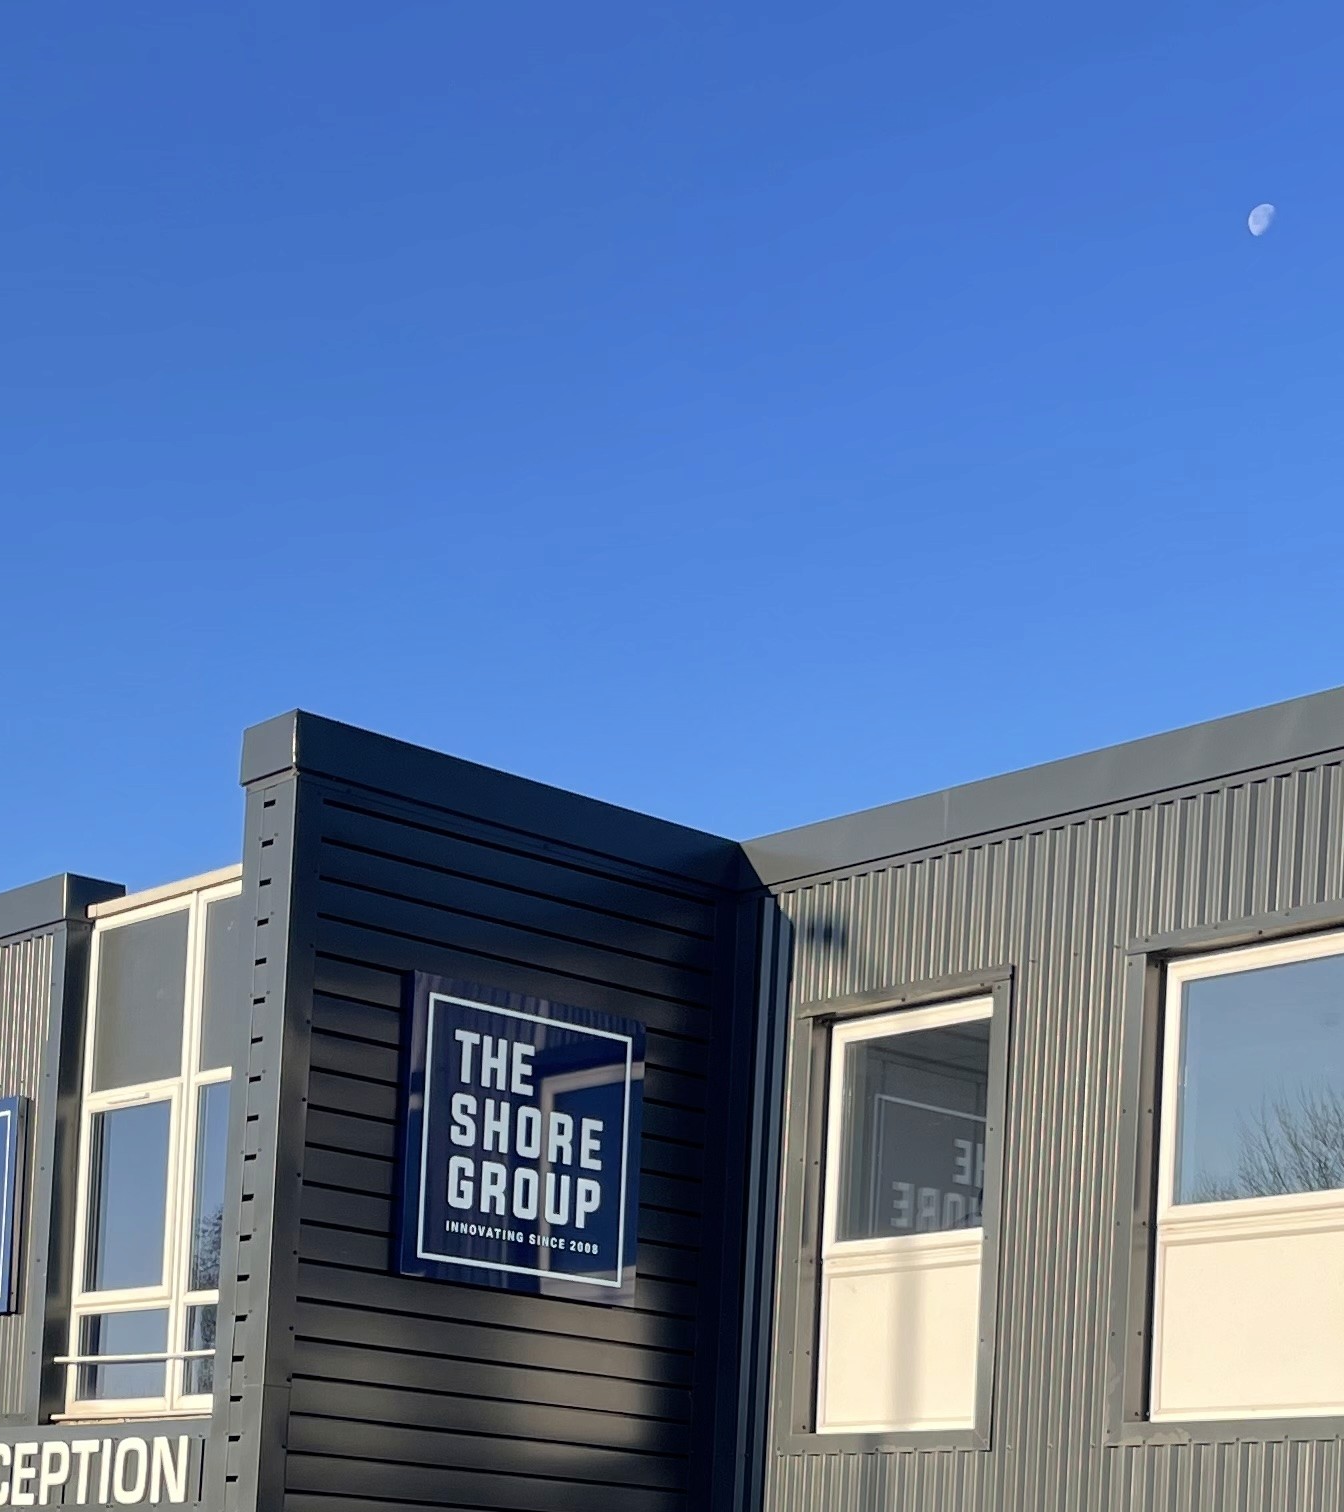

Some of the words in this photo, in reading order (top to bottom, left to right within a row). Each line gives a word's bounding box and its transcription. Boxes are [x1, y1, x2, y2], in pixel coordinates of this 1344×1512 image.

[455, 1029, 536, 1096] THE
[450, 1093, 604, 1171] SHORE
[447, 1156, 601, 1229] GROUP
[445, 1220, 524, 1243] INNOVATING
[528, 1233, 565, 1250] SINCE
[570, 1240, 599, 1255] 2008
